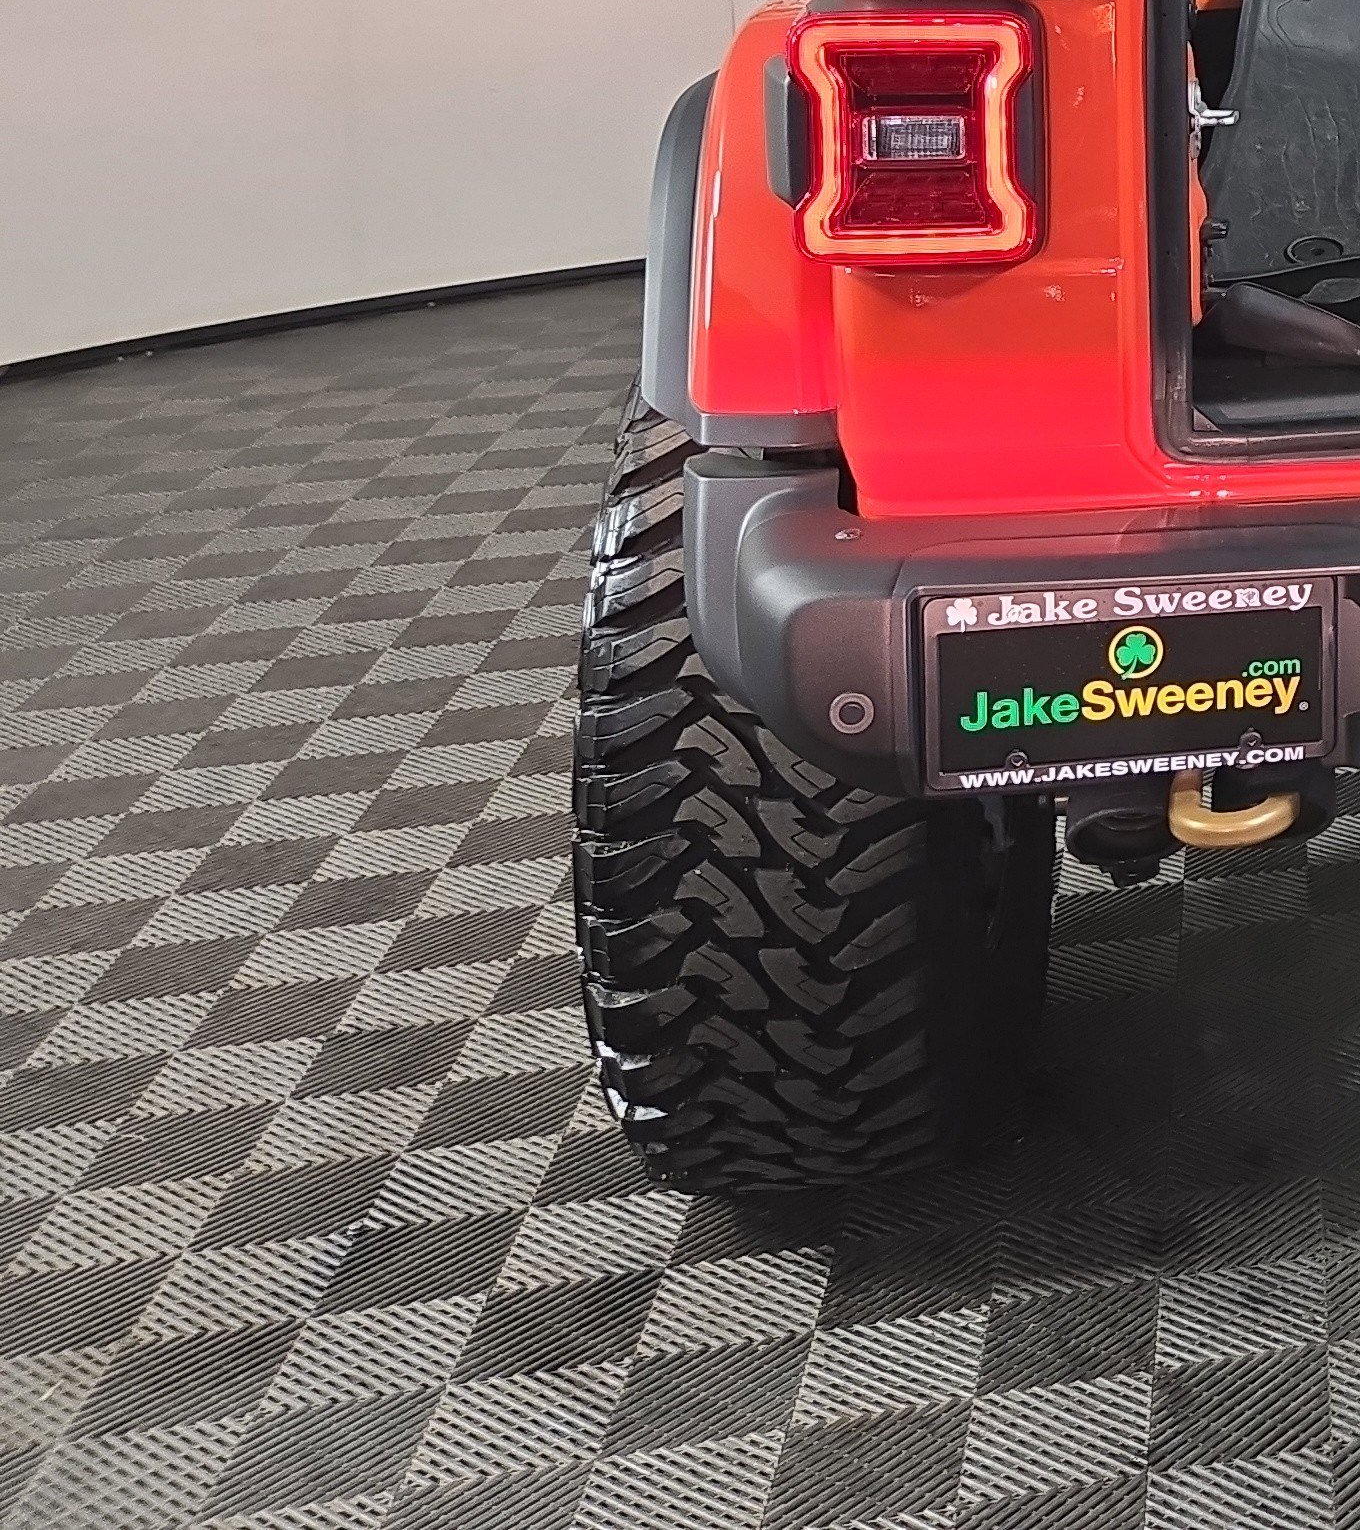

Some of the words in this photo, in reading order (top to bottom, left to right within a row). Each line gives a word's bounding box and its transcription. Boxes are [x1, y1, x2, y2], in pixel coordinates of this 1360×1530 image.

[987, 591, 1098, 627] Jake
[1113, 583, 1313, 618] Sweeney
[1241, 658, 1301, 678] .com
[960, 745, 1305, 790] WWW.JAKESWEENEY.COM
